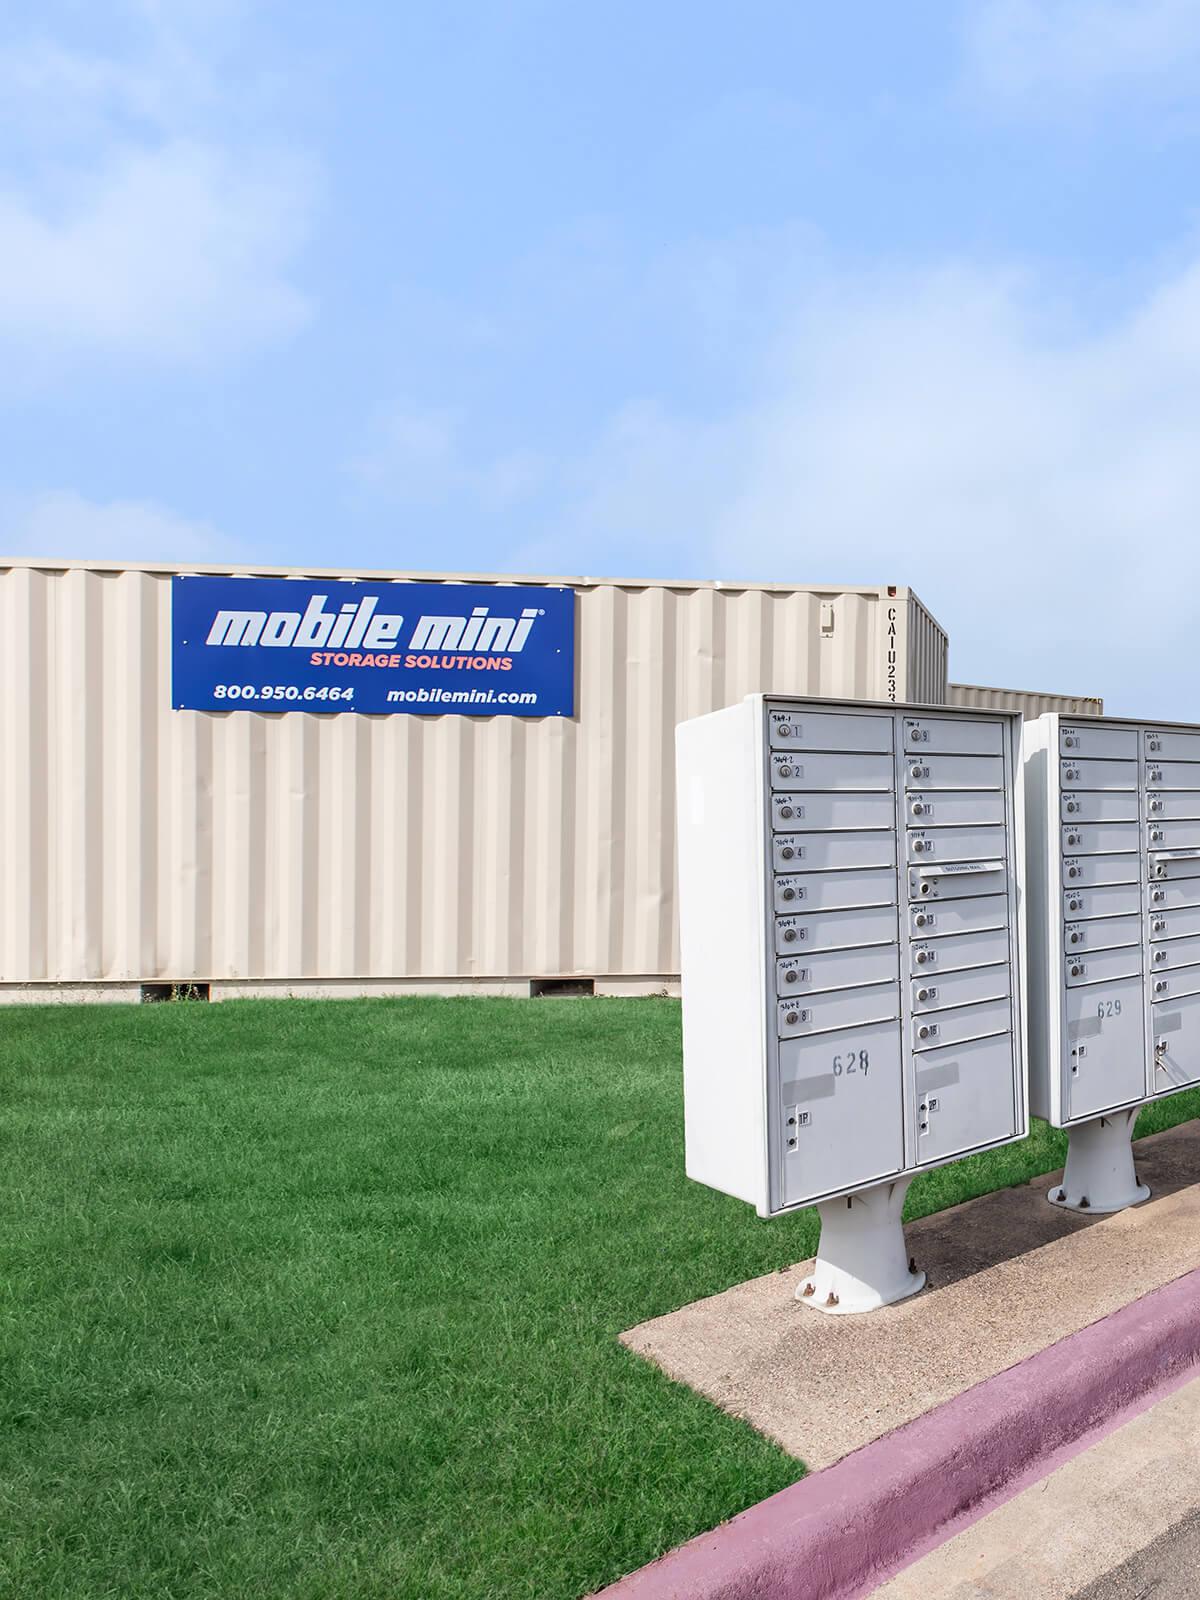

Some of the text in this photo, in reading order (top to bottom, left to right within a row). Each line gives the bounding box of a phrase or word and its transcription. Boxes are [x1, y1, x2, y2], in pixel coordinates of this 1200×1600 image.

[205, 595, 539, 653] mobile mini
[309, 652, 513, 671] STORAGE SOLUTIONS
[213, 684, 354, 701] 800.950.6464
[386, 688, 538, 705] mobilemini.com
[794, 726, 798, 737] 1
[795, 766, 800, 777] 2
[923, 767, 930, 778] 10
[796, 807, 802, 818] 3
[924, 804, 931, 814] 11
[924, 841, 932, 851] 12
[797, 847, 802, 858] 4
[798, 888, 803, 899] 5
[927, 915, 934, 925] 13
[800, 929, 805, 940] 6
[800, 970, 806, 981] 7
[928, 988, 936, 999] 15
[1097, 1000, 1121, 1019] 629
[801, 1010, 806, 1021] 8
[833, 1049, 869, 1077] 628
